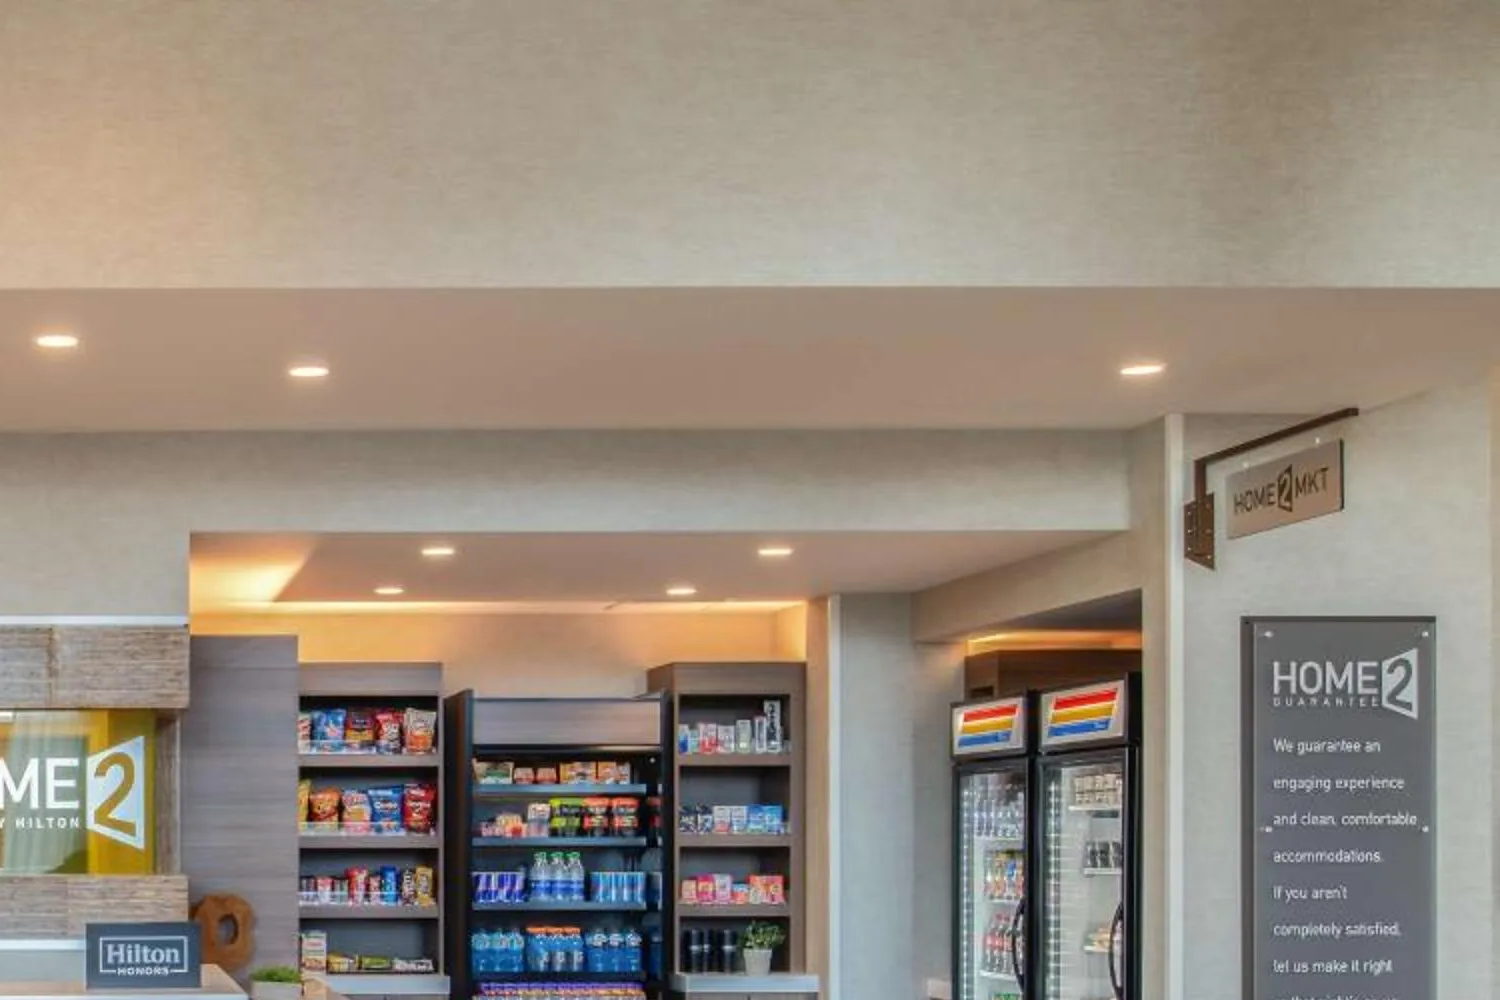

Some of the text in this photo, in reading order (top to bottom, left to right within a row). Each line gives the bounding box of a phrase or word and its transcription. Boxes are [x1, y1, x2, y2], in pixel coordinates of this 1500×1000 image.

[1273, 737, 1381, 756] We guarantee an
[1273, 775, 1405, 792] engaging experience
[16, 817, 80, 829] HILTON
[1273, 812, 1297, 825] and
[1341, 811, 1417, 825] comfortable
[1273, 885, 1282, 899] If
[1285, 888, 1308, 903] you
[1273, 922, 1342, 940] completely
[105, 943, 181, 965] Hilton
[117, 966, 169, 977] HONORS
[1273, 959, 1393, 976] let us make it right
